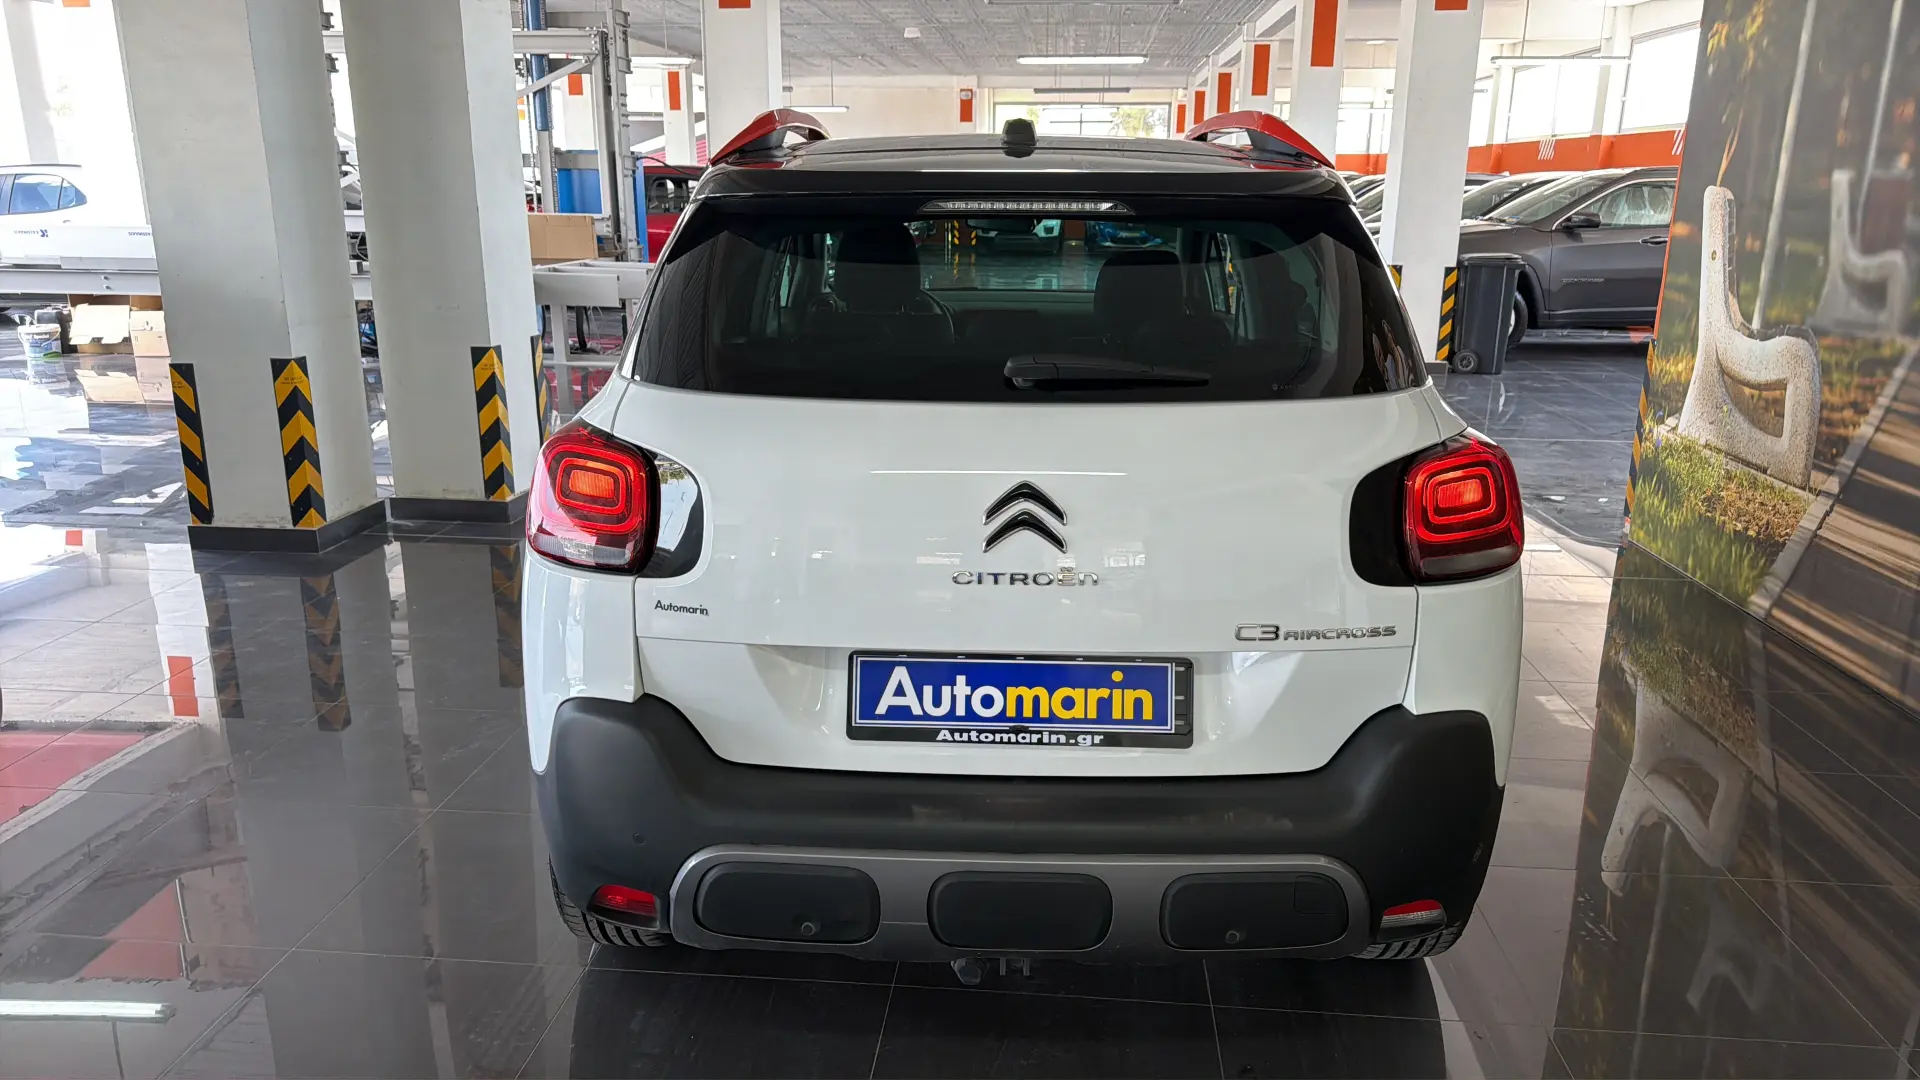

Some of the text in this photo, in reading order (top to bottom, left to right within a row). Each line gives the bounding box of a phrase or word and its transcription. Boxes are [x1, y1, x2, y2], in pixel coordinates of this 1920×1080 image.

[654, 600, 709, 616] Automarin
[1235, 624, 1397, 641] C3 AIRCROSS
[874, 666, 1153, 720] Automarin
[936, 729, 1104, 746] Automarin.gr
